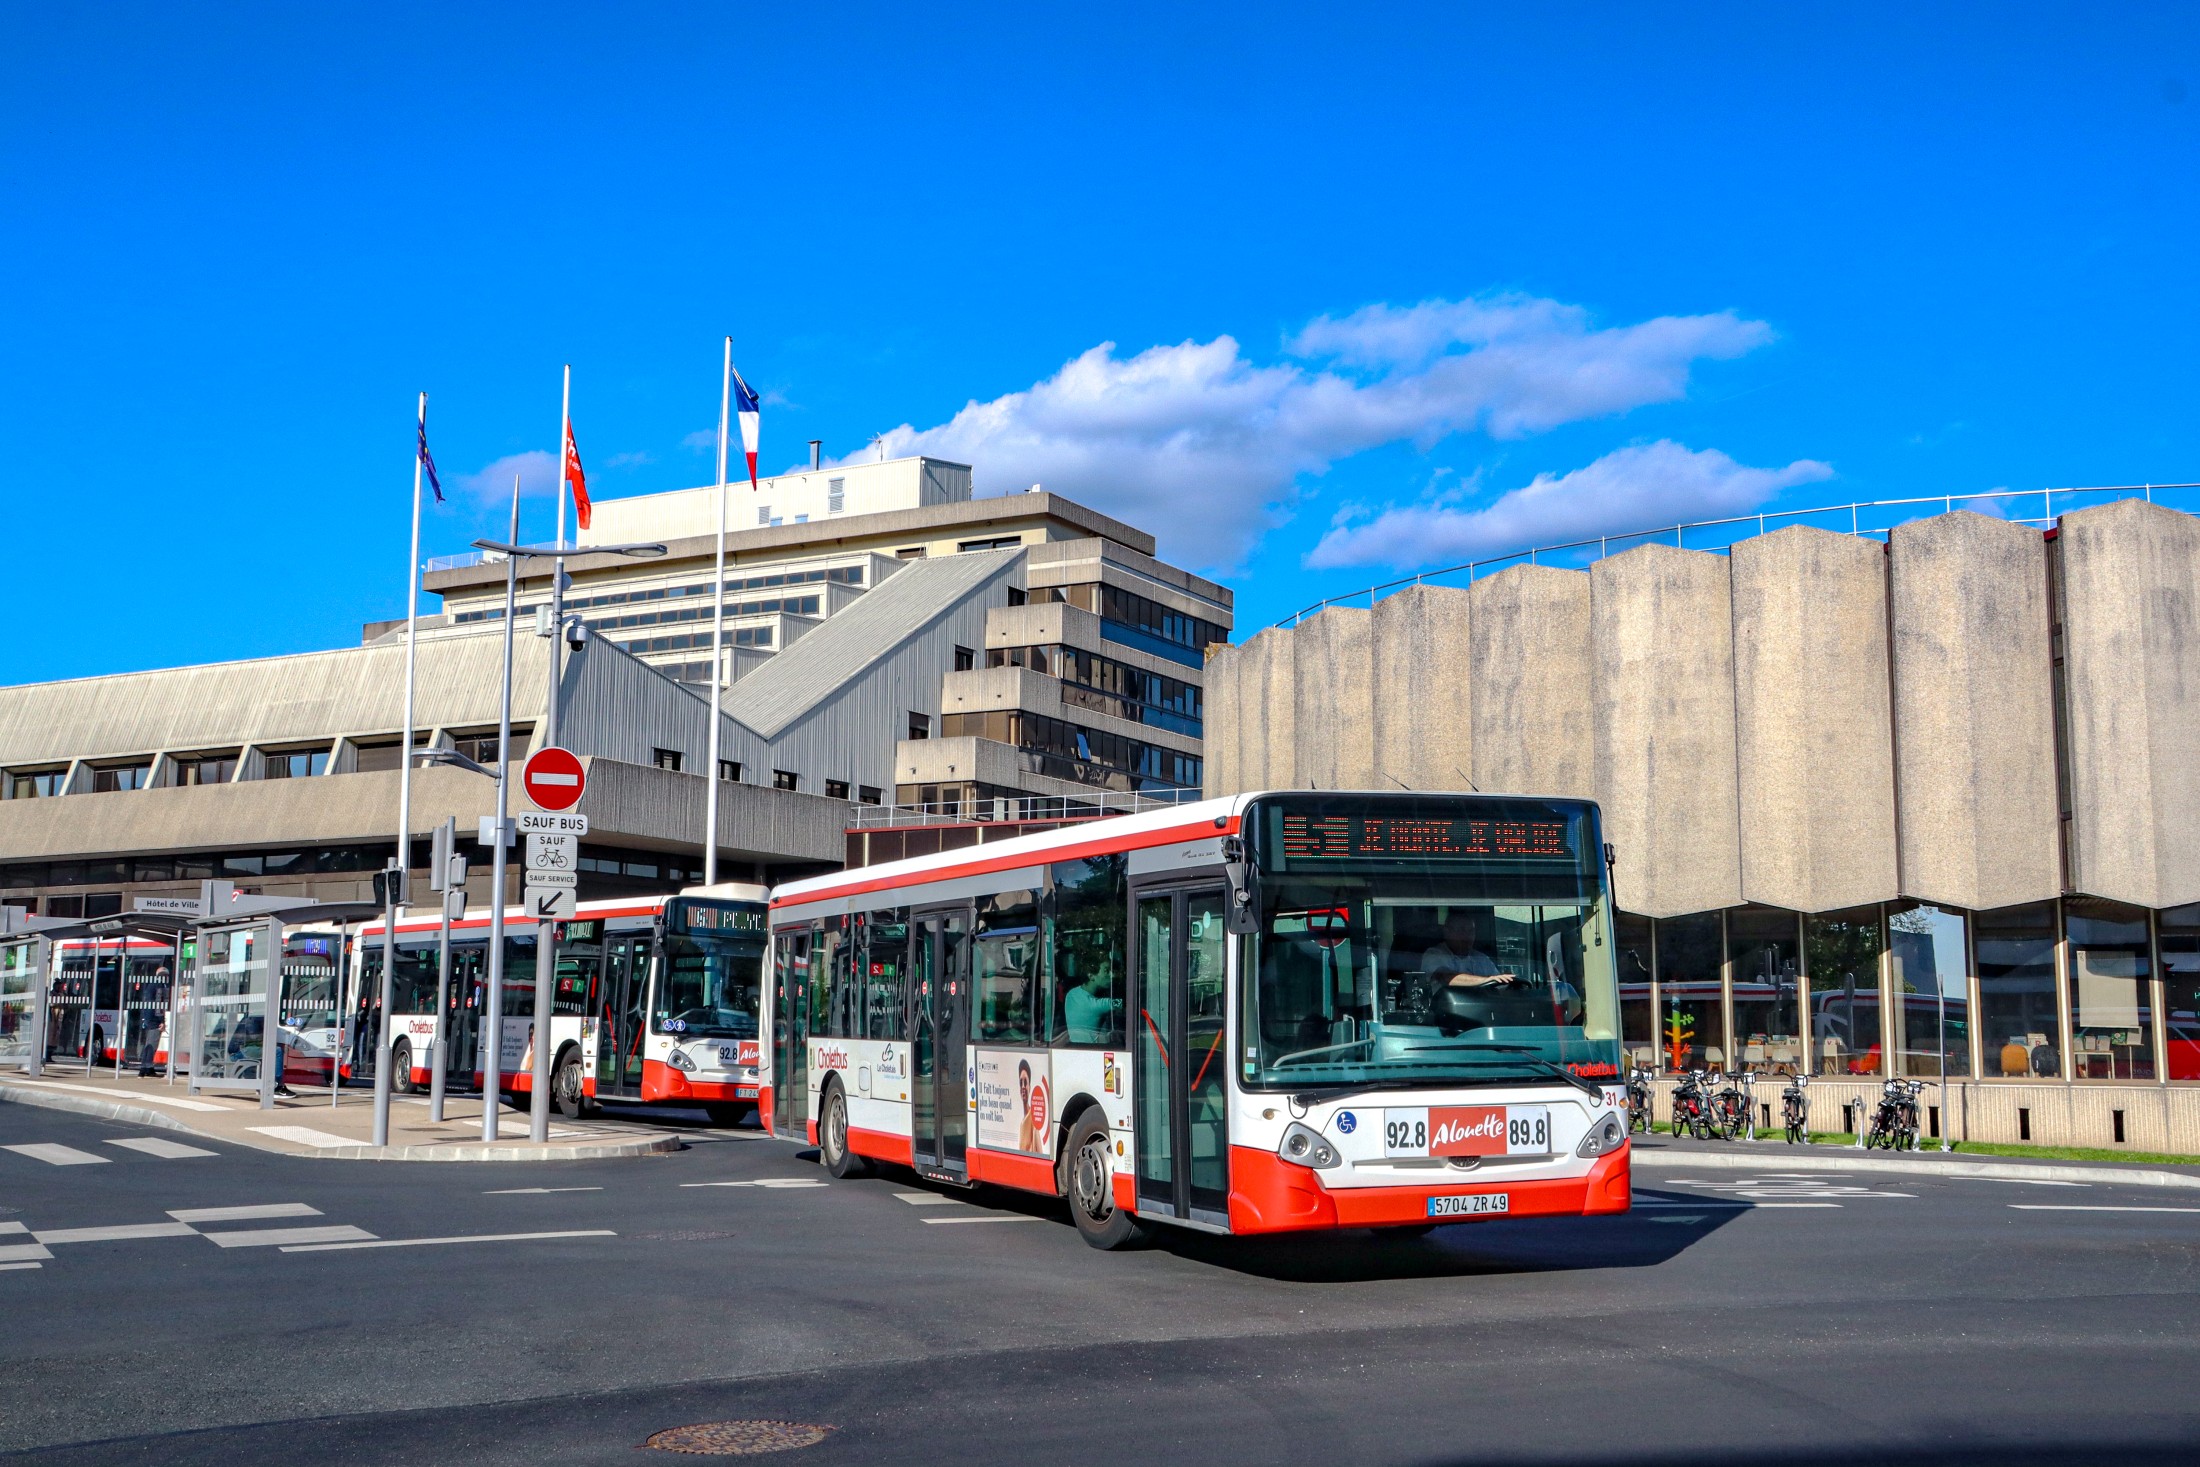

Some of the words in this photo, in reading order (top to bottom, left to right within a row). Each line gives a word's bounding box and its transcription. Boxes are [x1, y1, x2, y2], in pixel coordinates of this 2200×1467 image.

[523, 816, 555, 829] SAUF
[560, 818, 584, 830] BUS
[540, 836, 565, 845] SAUF
[548, 875, 574, 883] SERVICE
[146, 900, 168, 908] Hôtel
[169, 900, 179, 908] de
[182, 901, 199, 909] Ville
[187, 945, 194, 956] 1
[719, 1047, 738, 1060] 92.8
[818, 1047, 848, 1069] Choletbus
[1605, 1091, 1617, 1106] 31
[1387, 1121, 1426, 1148] 92.8
[1432, 1113, 1505, 1149] Alouette
[1509, 1118, 1546, 1146] 89.8
[1435, 1197, 1467, 1213] 5704
[1473, 1196, 1488, 1211] ZR
[1491, 1195, 1506, 1211] 49
